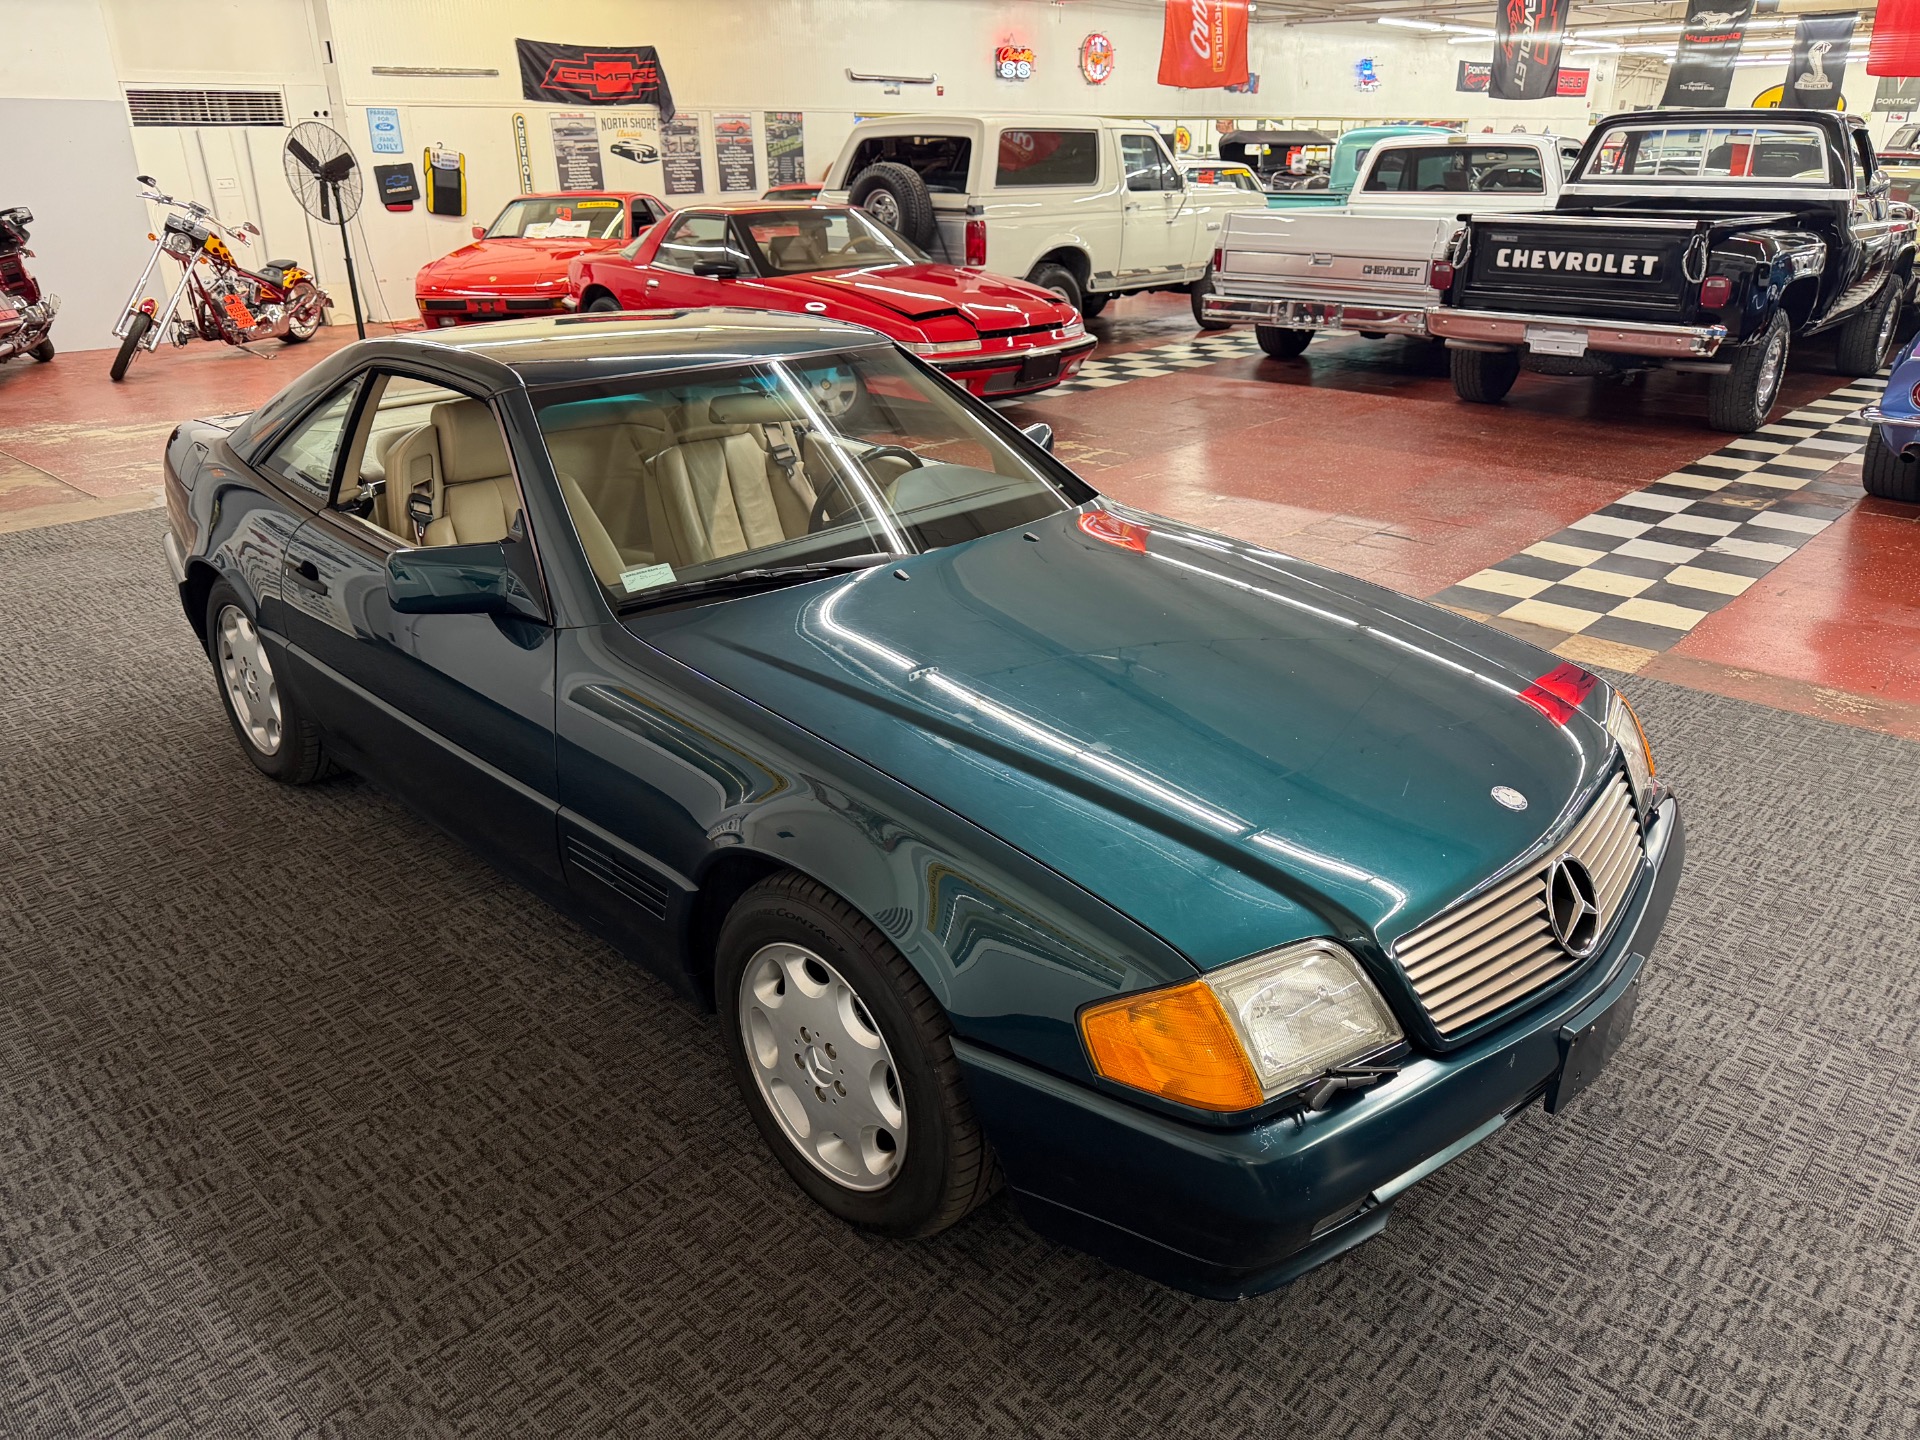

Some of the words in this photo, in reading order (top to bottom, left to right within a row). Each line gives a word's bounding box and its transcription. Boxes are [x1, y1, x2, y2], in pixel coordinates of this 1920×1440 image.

[1684, 32, 1741, 43] MUSTANG
[1001, 61, 1031, 78] SS
[1559, 77, 1585, 89] SHELBY
[1875, 97, 1917, 105] PONTIAC
[601, 117, 628, 131] NORTH
[630, 117, 657, 131] SHORE
[376, 143, 399, 151] ONLY
[1496, 249, 1659, 276] CHEVROLET
[1362, 265, 1421, 277] CHEVROLET
